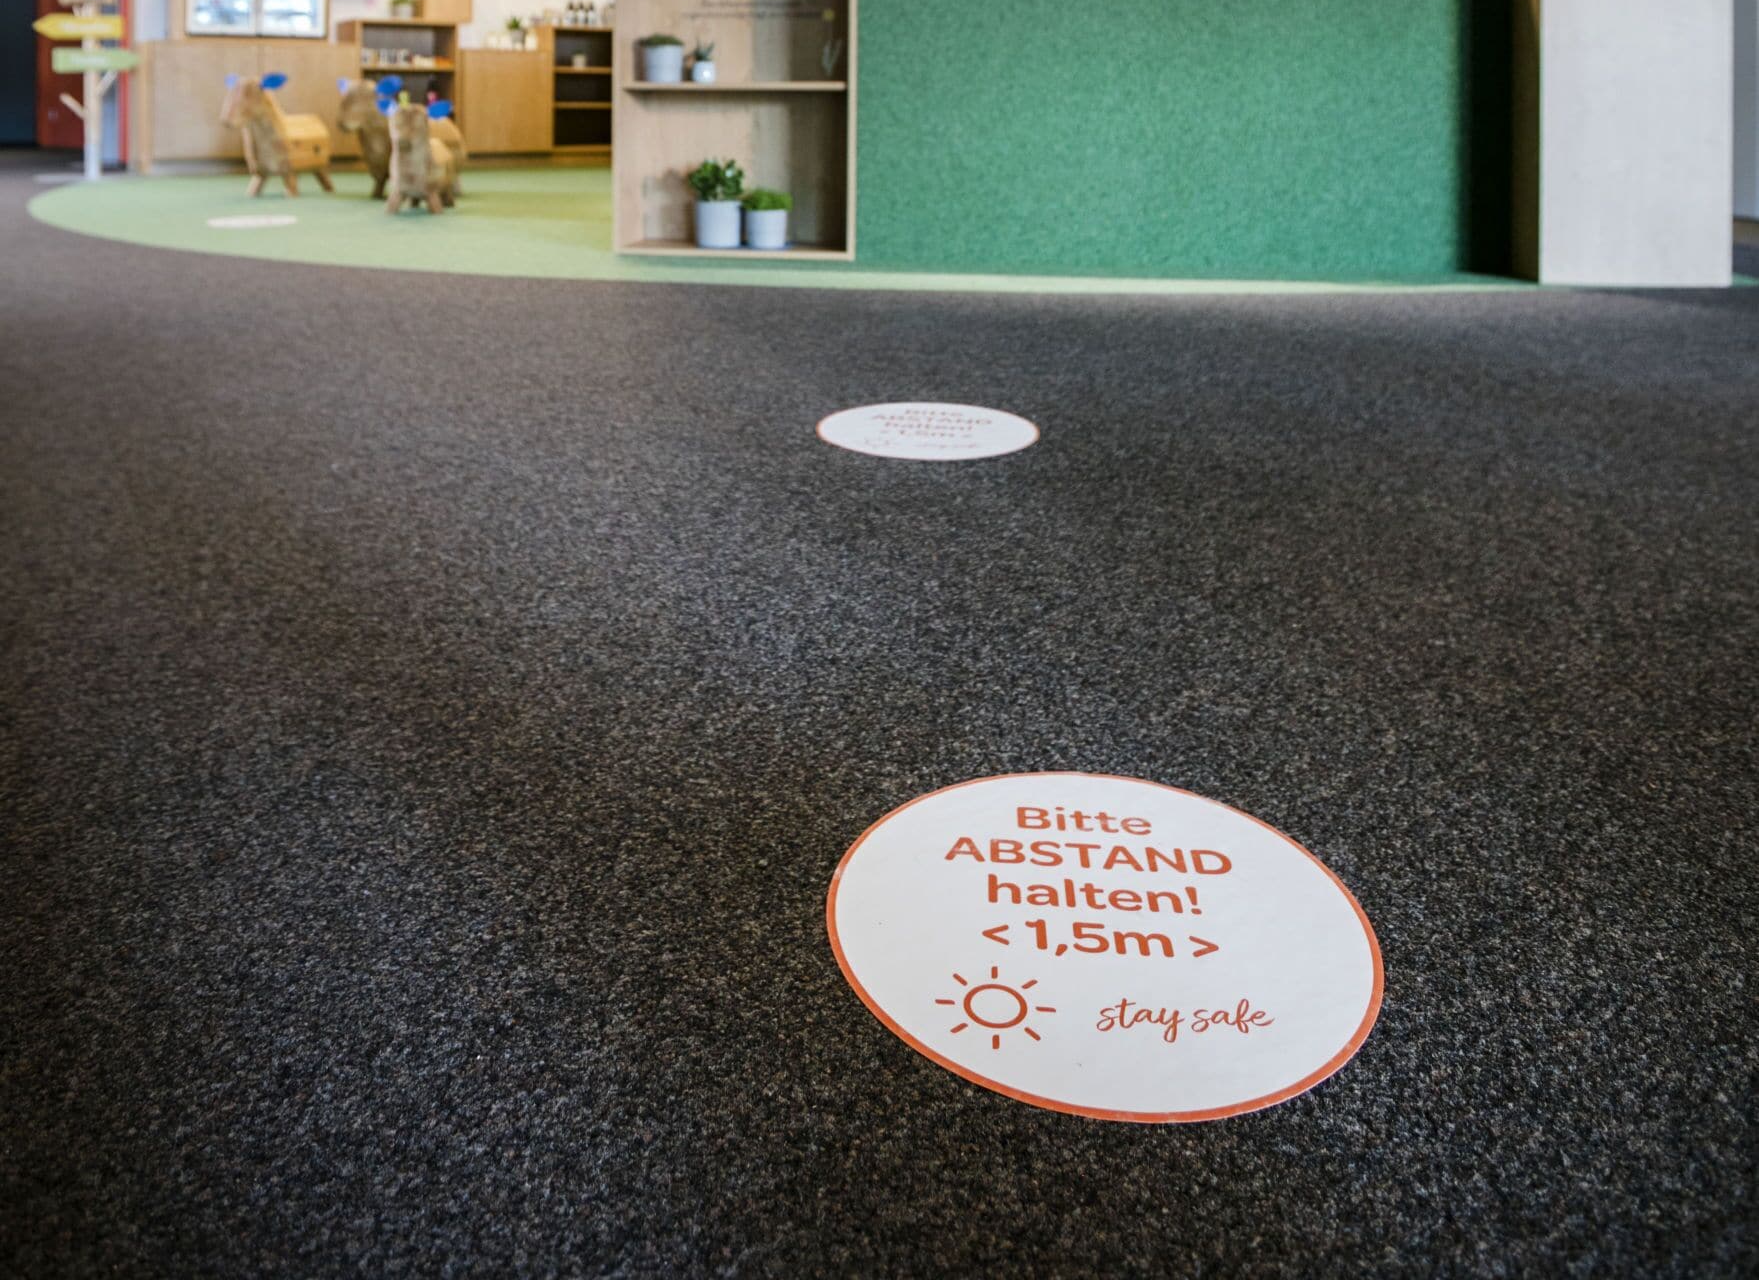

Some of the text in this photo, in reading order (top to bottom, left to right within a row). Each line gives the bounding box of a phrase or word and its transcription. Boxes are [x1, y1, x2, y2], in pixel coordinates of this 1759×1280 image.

[1016, 805, 1152, 836] Bitte
[944, 836, 1233, 876] ABSTAND
[987, 873, 1204, 915] halten!
[1096, 997, 1276, 1043] stay safe
